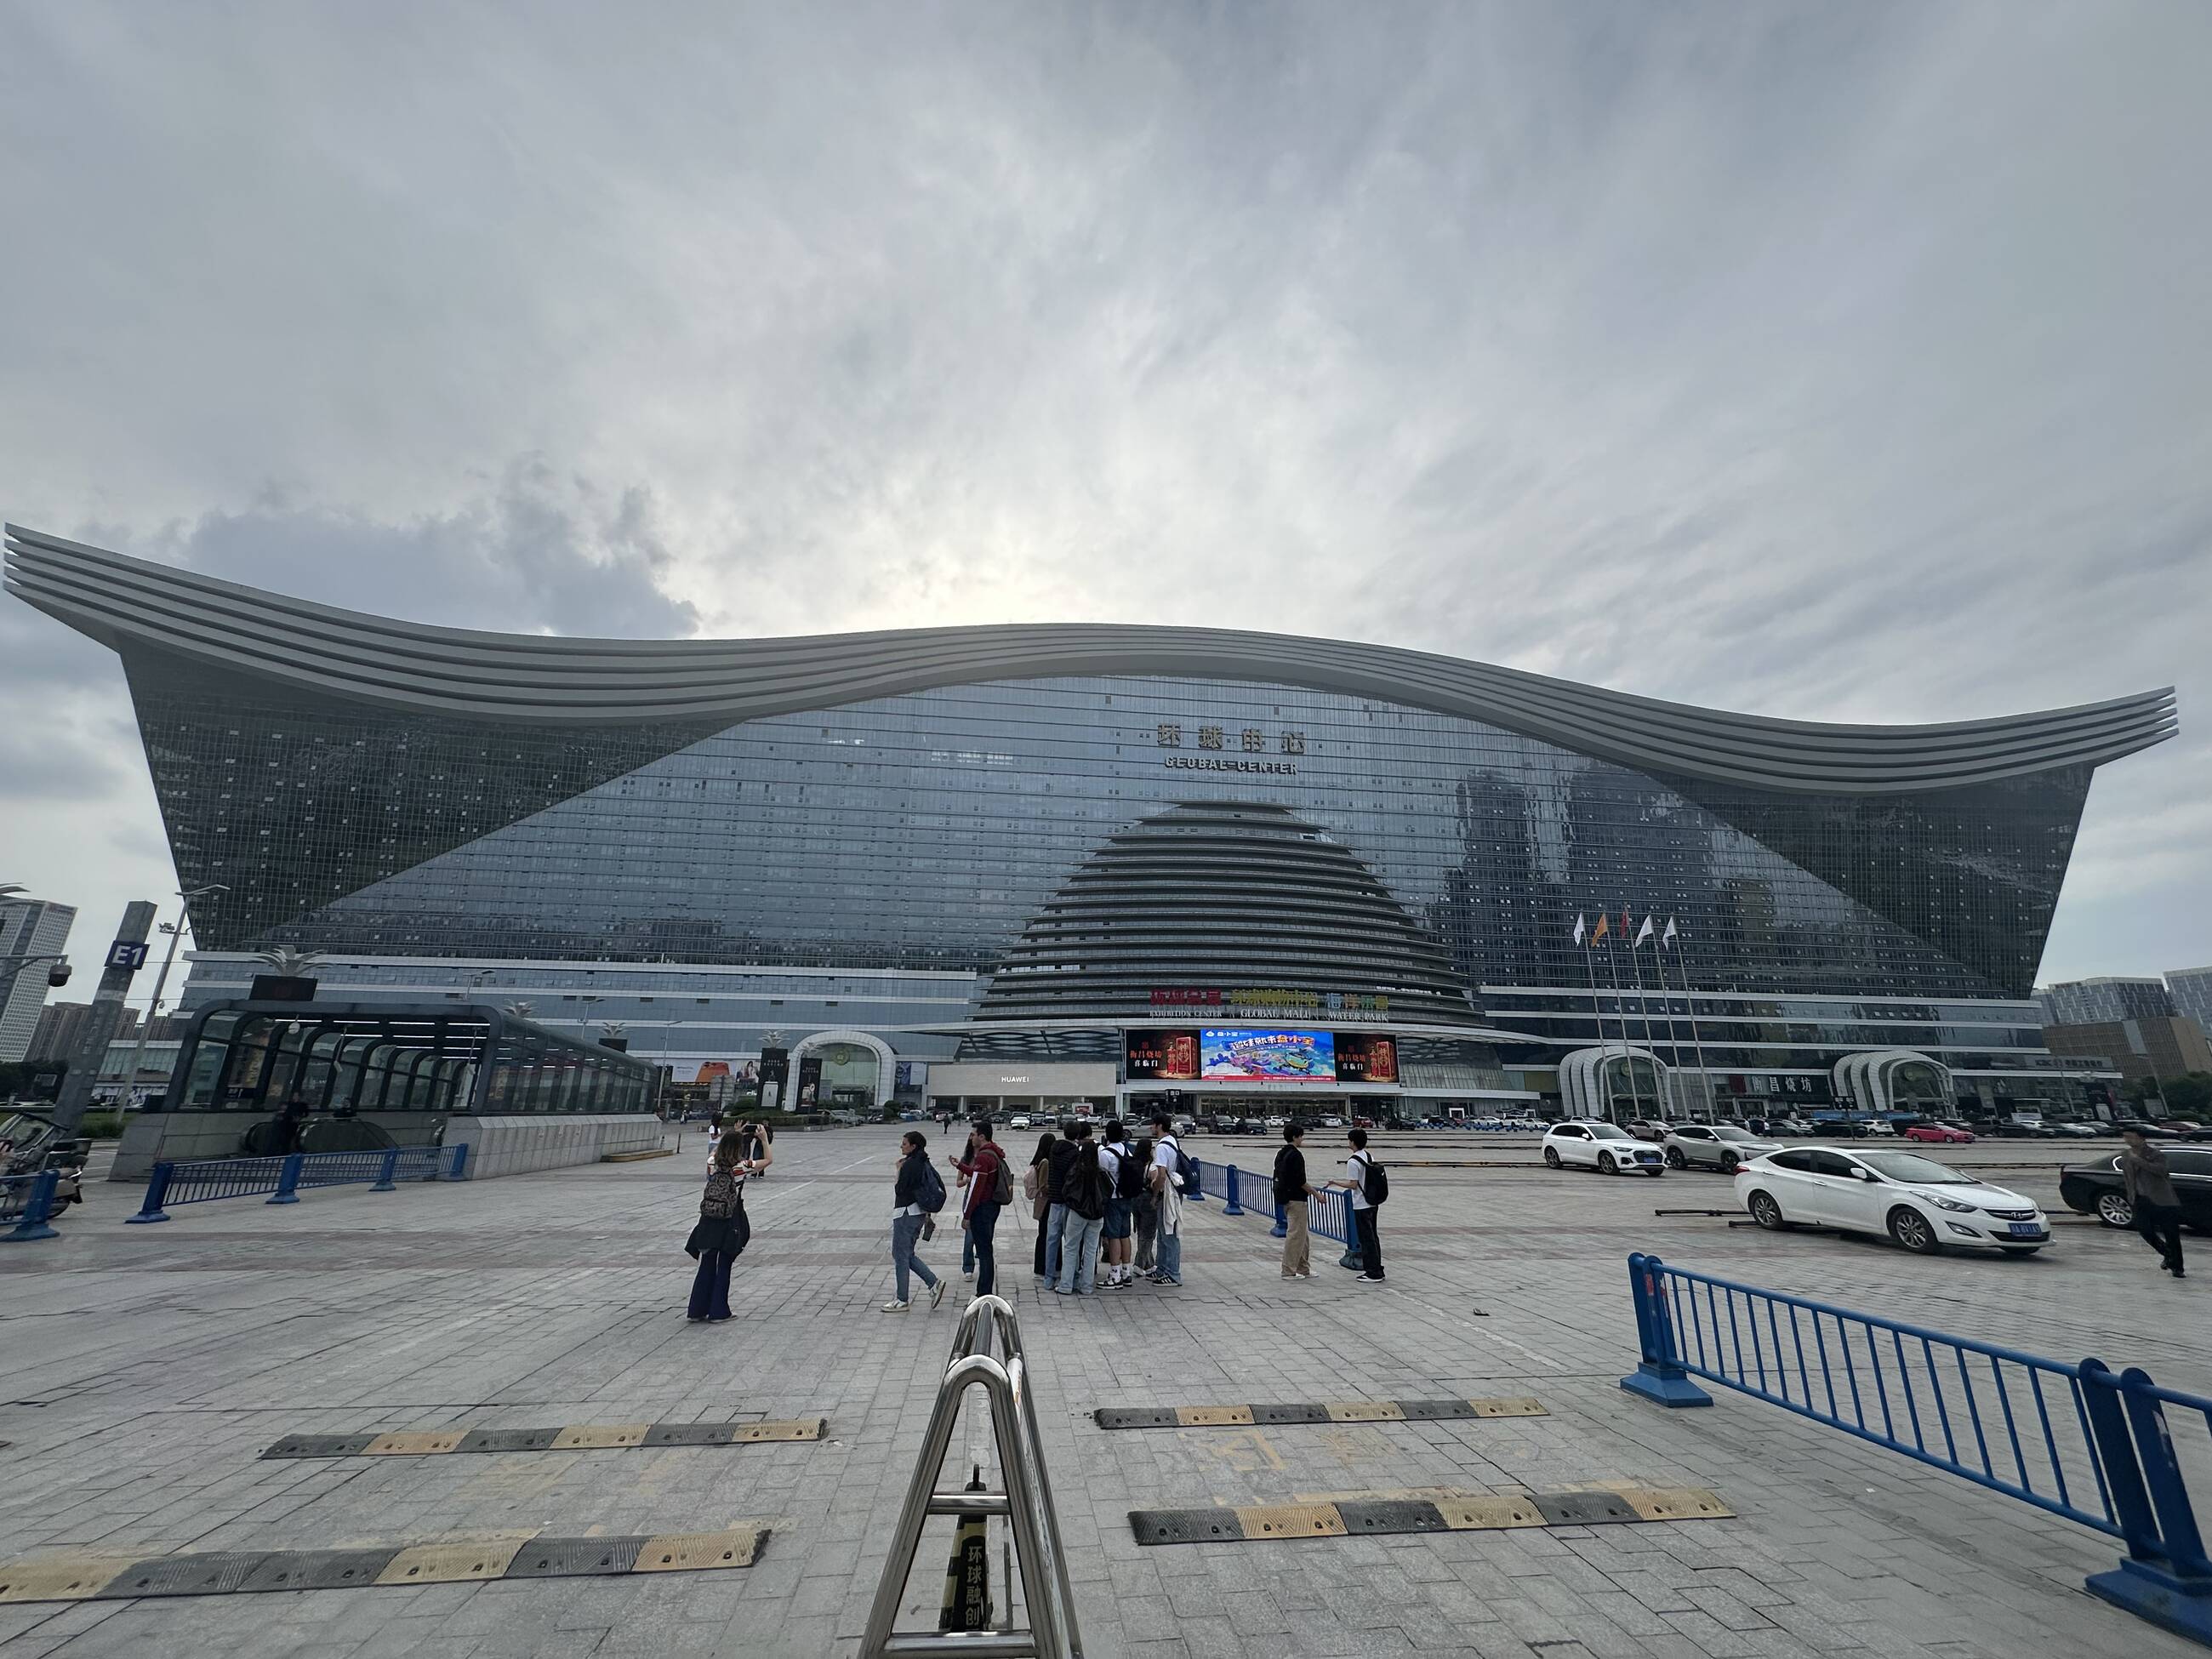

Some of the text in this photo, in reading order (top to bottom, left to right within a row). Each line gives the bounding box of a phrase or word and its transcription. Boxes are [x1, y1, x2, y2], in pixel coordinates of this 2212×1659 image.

[1157, 725, 1304, 754] 环球中心
[1165, 755, 1298, 775] GLOBAL CENTER
[111, 944, 143, 966] E1
[1240, 1008, 1310, 1019] GLOBAL MALL
[1329, 1011, 1388, 1022] WATER PARK
[1752, 1076, 1812, 1092] 衡昌烧坊
[966, 1545, 982, 1626] 环球融创
